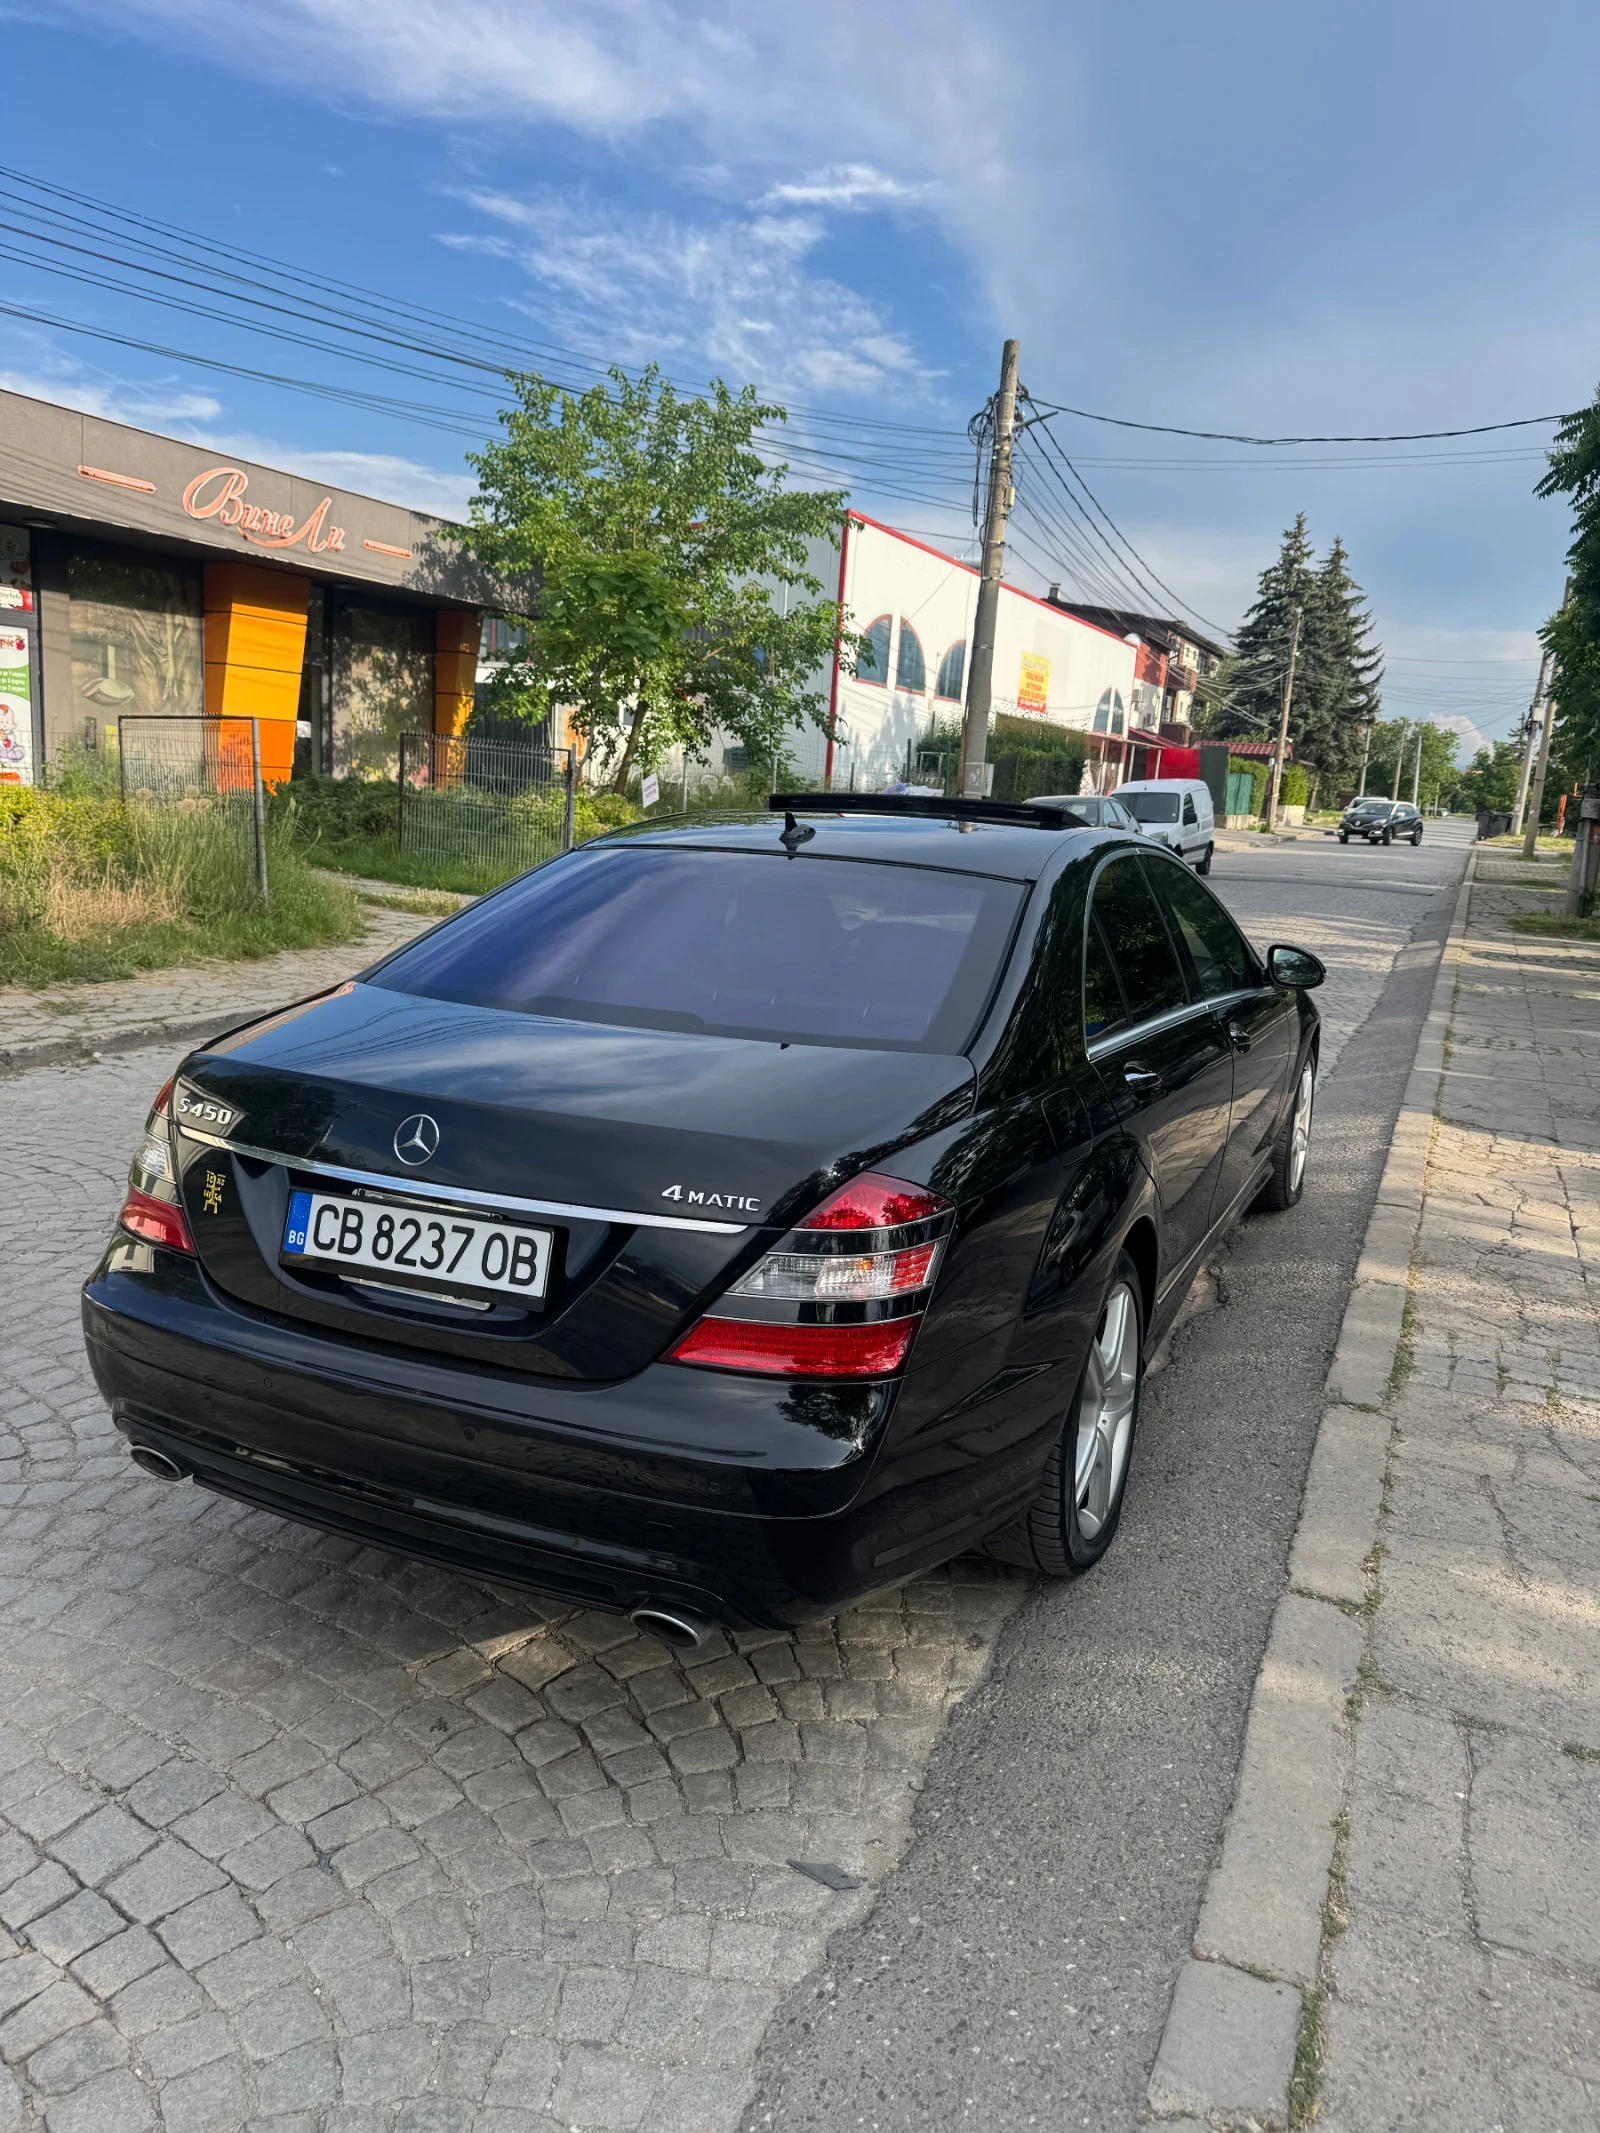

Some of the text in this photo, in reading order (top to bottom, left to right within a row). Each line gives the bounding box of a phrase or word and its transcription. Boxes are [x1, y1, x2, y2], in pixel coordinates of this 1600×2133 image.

[183, 467, 295, 538] Вине
[178, 1098, 232, 1125] S450
[288, 1229, 305, 1246] BG
[313, 1204, 538, 1286] CB 8237 OB
